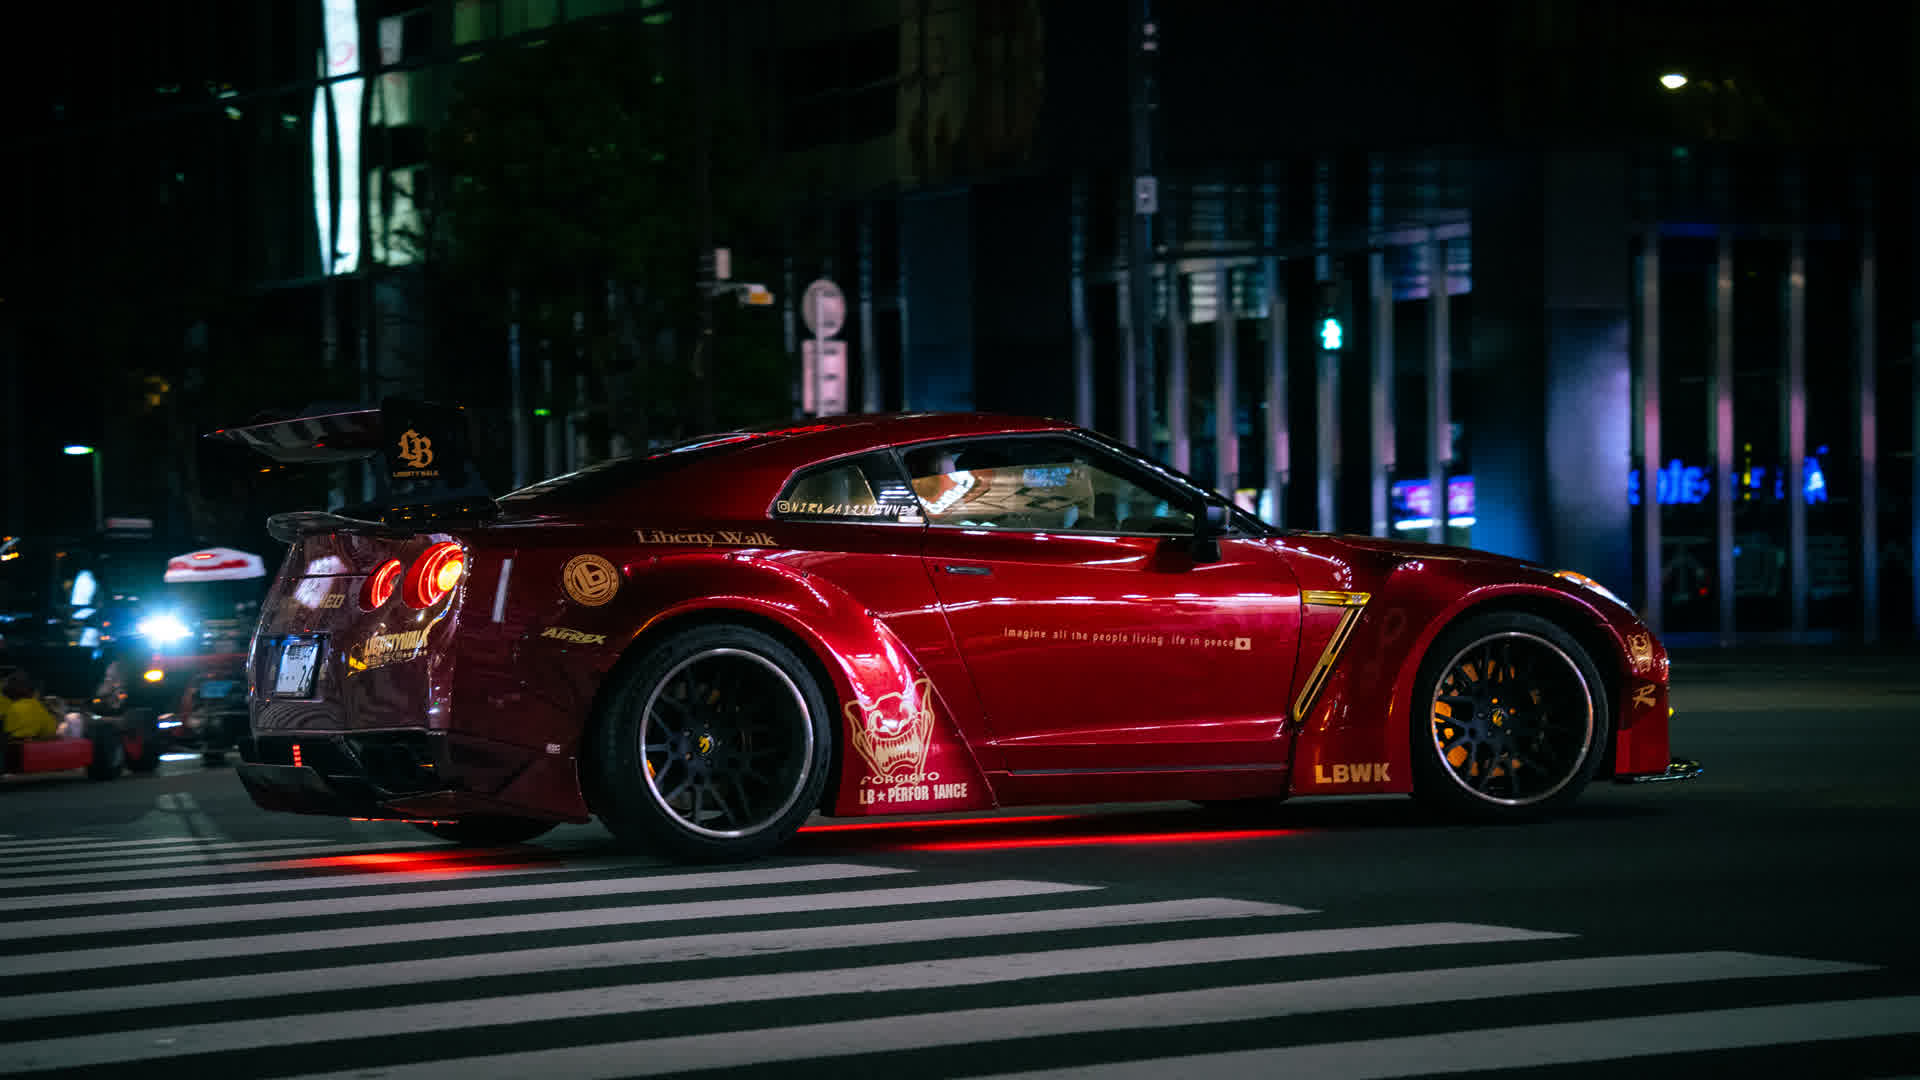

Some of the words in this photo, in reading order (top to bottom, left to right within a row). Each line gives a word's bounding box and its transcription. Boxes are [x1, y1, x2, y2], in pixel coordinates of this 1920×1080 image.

[634, 530, 714, 547] Liberty
[718, 530, 777, 546] Walk
[1004, 627, 1046, 640] Imagine
[1053, 629, 1068, 639] all
[1072, 631, 1088, 640] the
[1093, 632, 1128, 644] people
[1133, 632, 1162, 647] living
[1204, 639, 1234, 648] peace
[1315, 762, 1392, 784] LBWK
